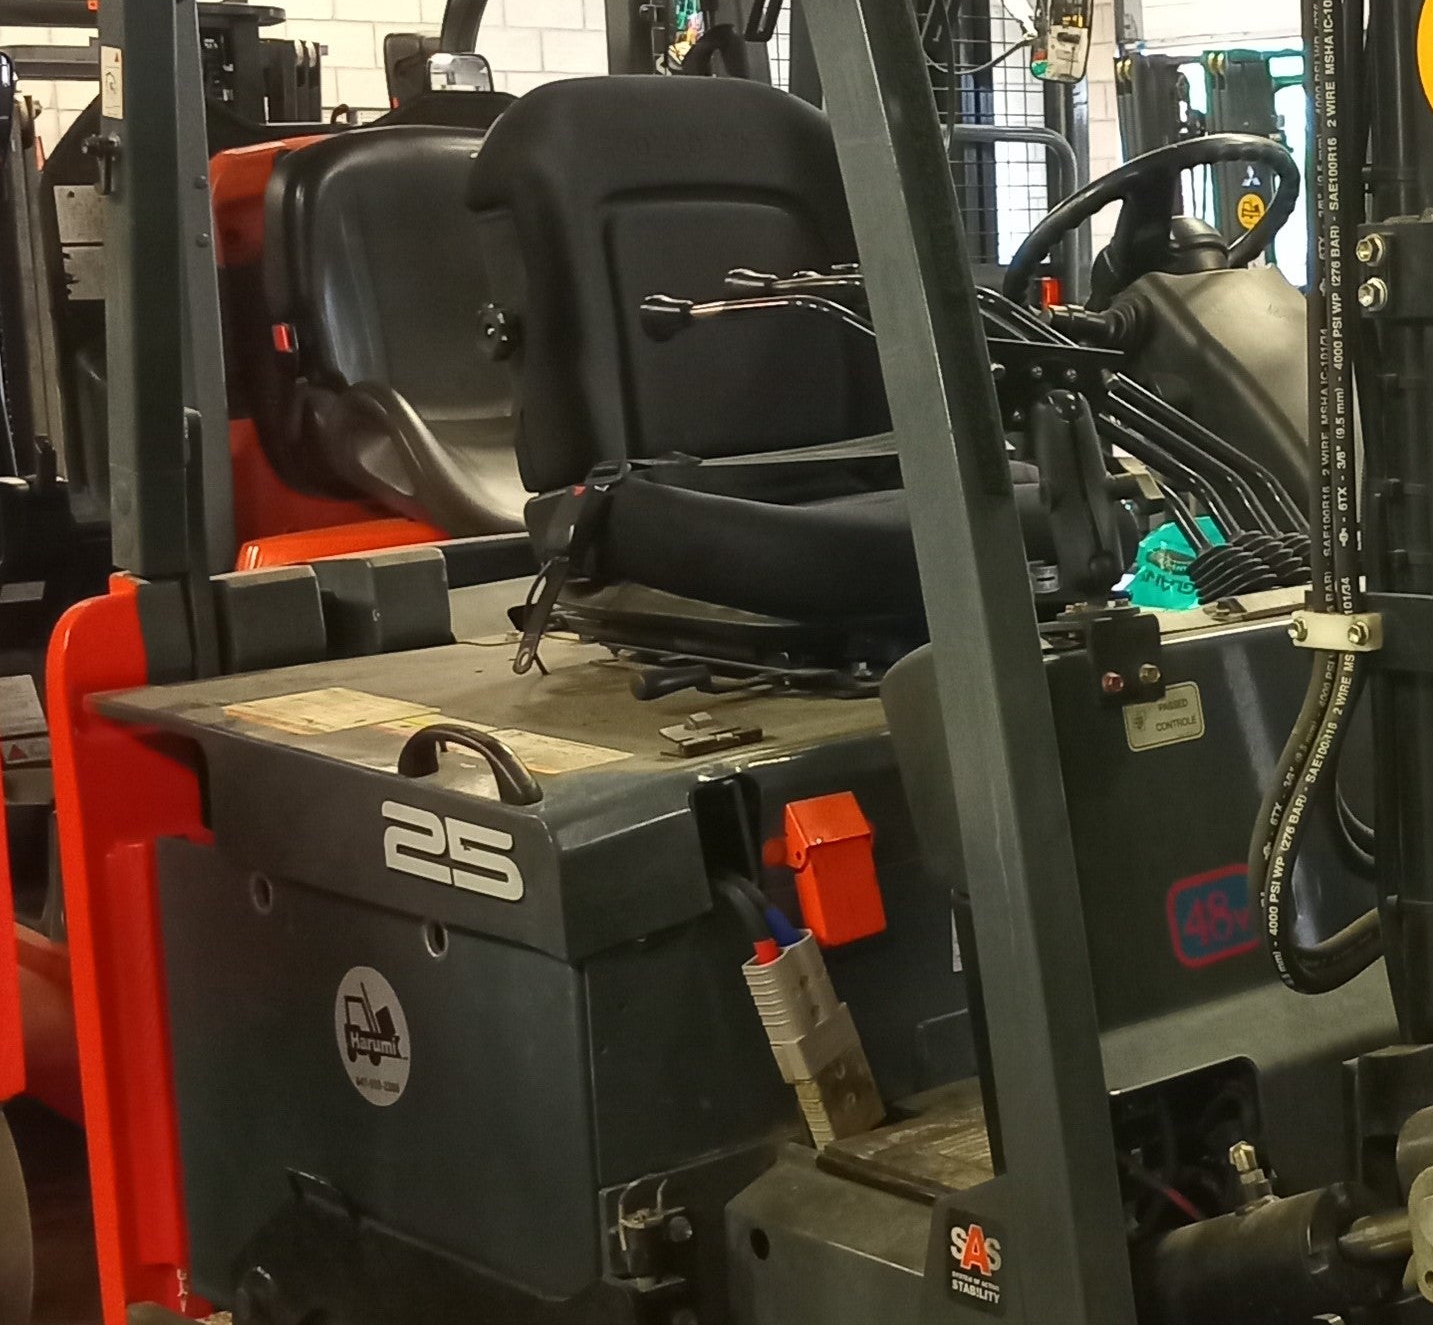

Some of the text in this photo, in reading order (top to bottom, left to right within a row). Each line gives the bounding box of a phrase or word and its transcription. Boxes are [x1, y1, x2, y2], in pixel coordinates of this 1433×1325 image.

[1324, 35, 1335, 75] MSHA
[1325, 81, 1336, 116] WIRE
[1327, 137, 1339, 211] SAE100R16
[1329, 225, 1340, 257] BAR)
[1331, 292, 1342, 314] WP
[1332, 317, 1343, 337] PSI
[1333, 341, 1344, 370] 4000
[1337, 486, 1348, 511] 6TX
[1335, 676, 1352, 706] WIRE
[381, 800, 525, 902] 25
[1273, 856, 1286, 878] WP
[1269, 880, 1281, 903] PSI
[1269, 906, 1280, 935] 4000
[950, 1223, 1002, 1276] SAS
[952, 1279, 1000, 1304] STABILITY
